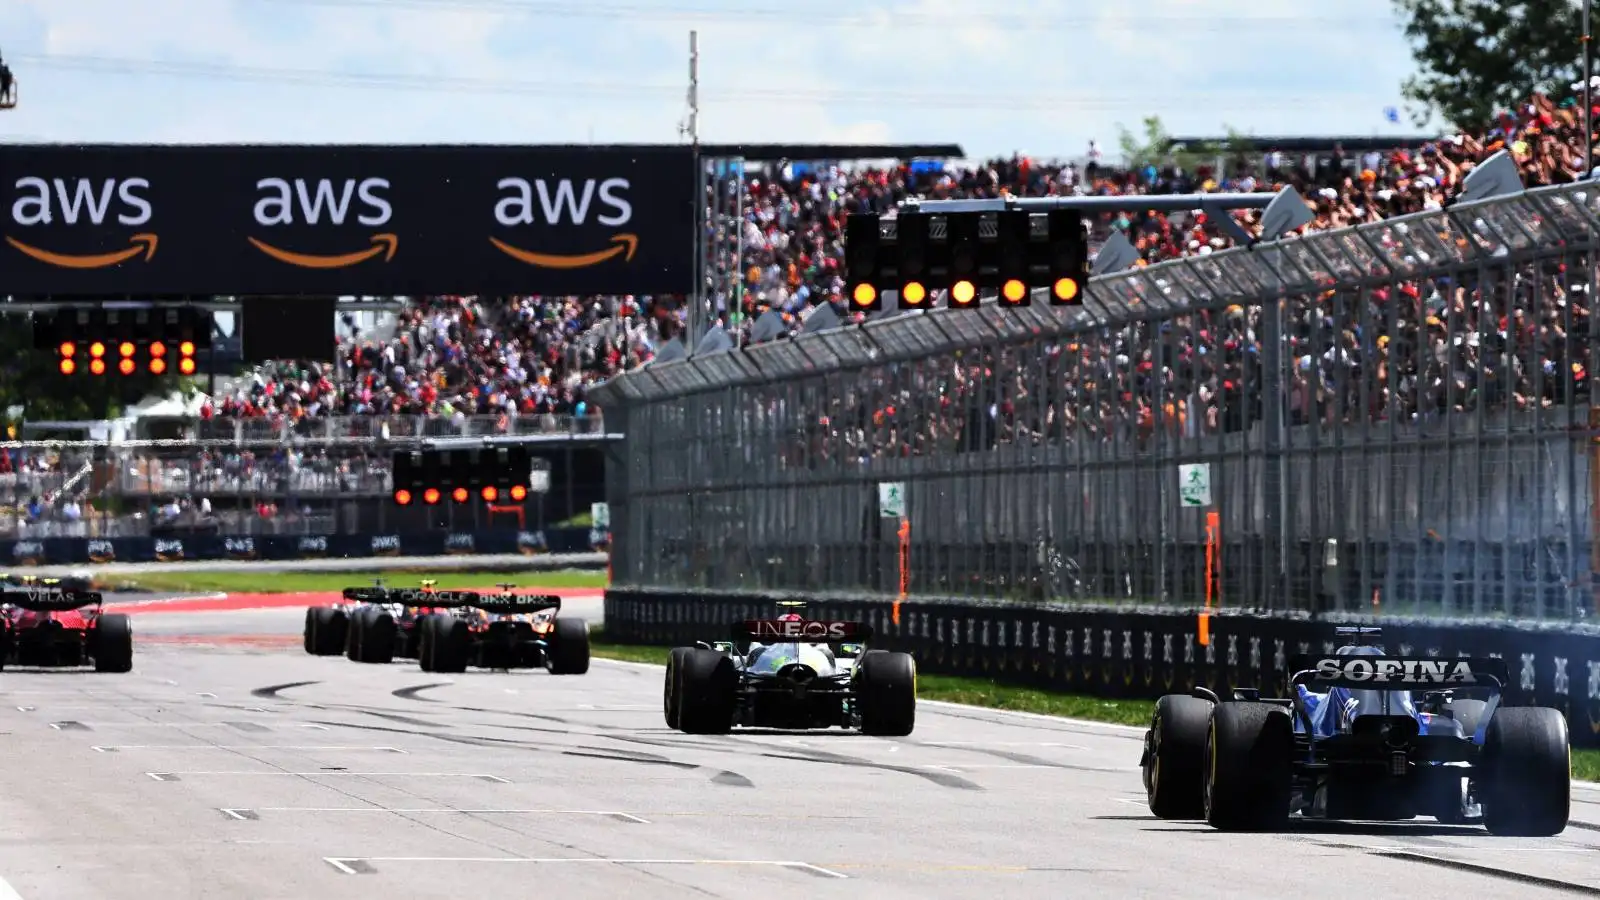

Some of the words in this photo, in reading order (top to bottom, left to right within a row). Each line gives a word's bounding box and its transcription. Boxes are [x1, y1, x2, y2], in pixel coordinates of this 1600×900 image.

[12, 176, 152, 226] aws
[253, 177, 392, 226] aws
[493, 177, 632, 226] aws
[1180, 486, 1206, 495] EXIT
[27, 591, 75, 602] VELAS
[400, 591, 470, 602] ORACLE
[755, 621, 846, 638] INEOS
[1314, 658, 1477, 683] SOFINA
